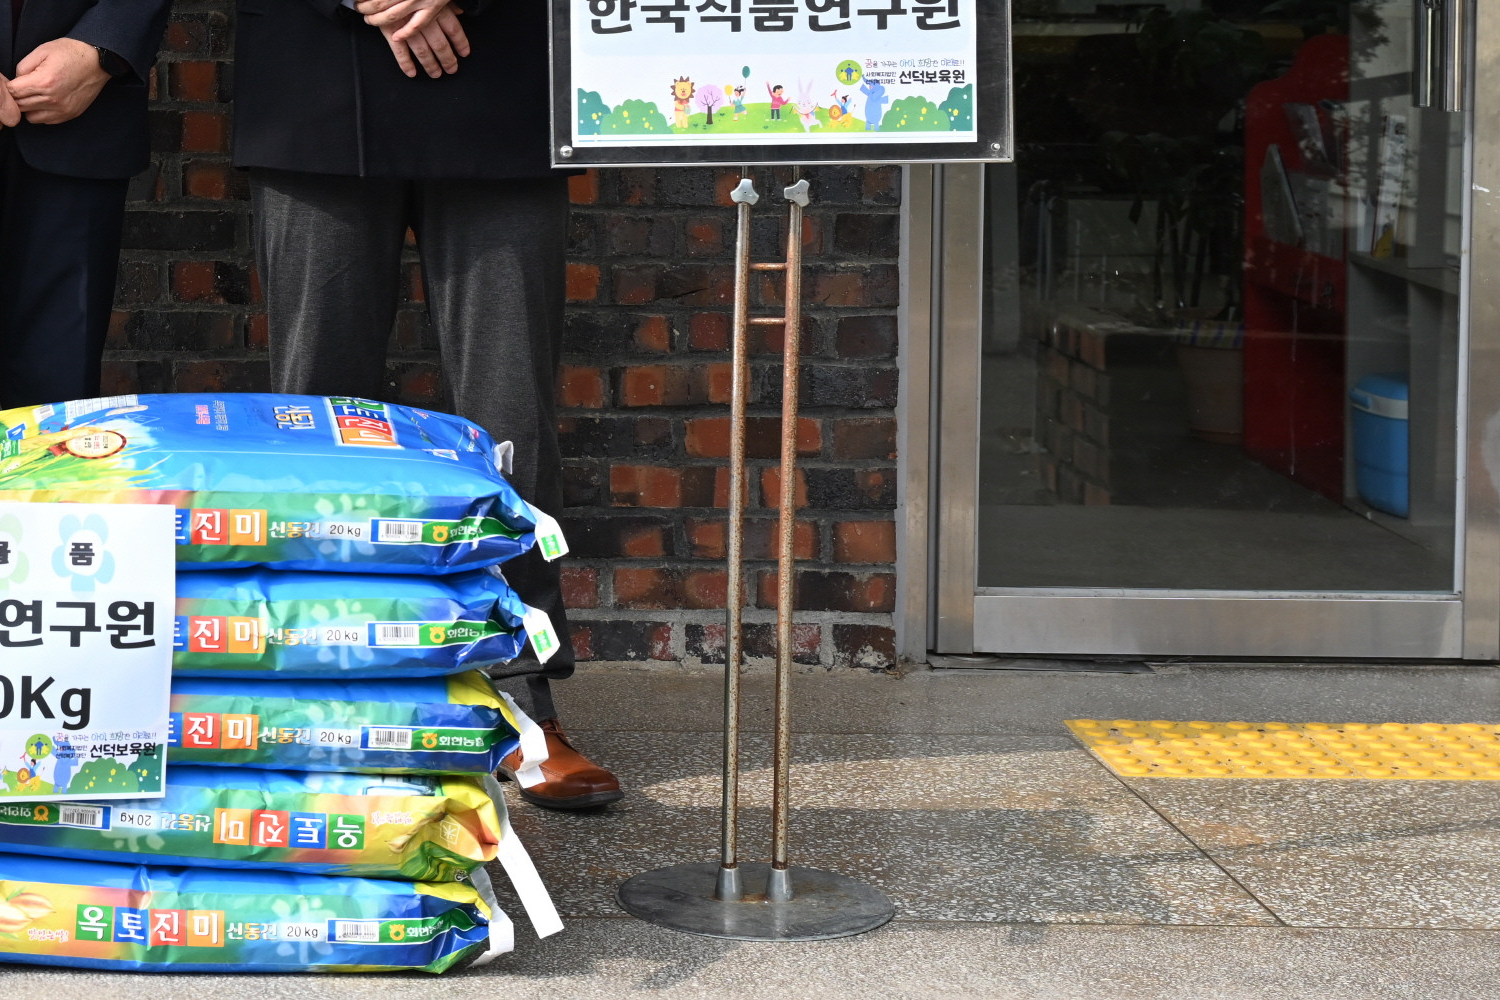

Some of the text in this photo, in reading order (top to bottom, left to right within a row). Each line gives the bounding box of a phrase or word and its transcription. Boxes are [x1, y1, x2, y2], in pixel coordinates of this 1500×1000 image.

[899, 69, 966, 85] 선덕보육원
[269, 521, 322, 539] 신동진
[329, 524, 344, 536] 20
[346, 525, 362, 538] kg
[267, 627, 319, 646] 신동진
[326, 630, 341, 642] 20
[344, 630, 359, 644] kg
[258, 727, 312, 745] 신동진
[320, 731, 335, 743] 20
[336, 731, 352, 745] kg
[90, 742, 156, 759] 선덕보육원
[120, 809, 363, 848] 옥토진미 신동진 20 kg
[77, 905, 319, 944] 옥토진미 신동진 20 kg
